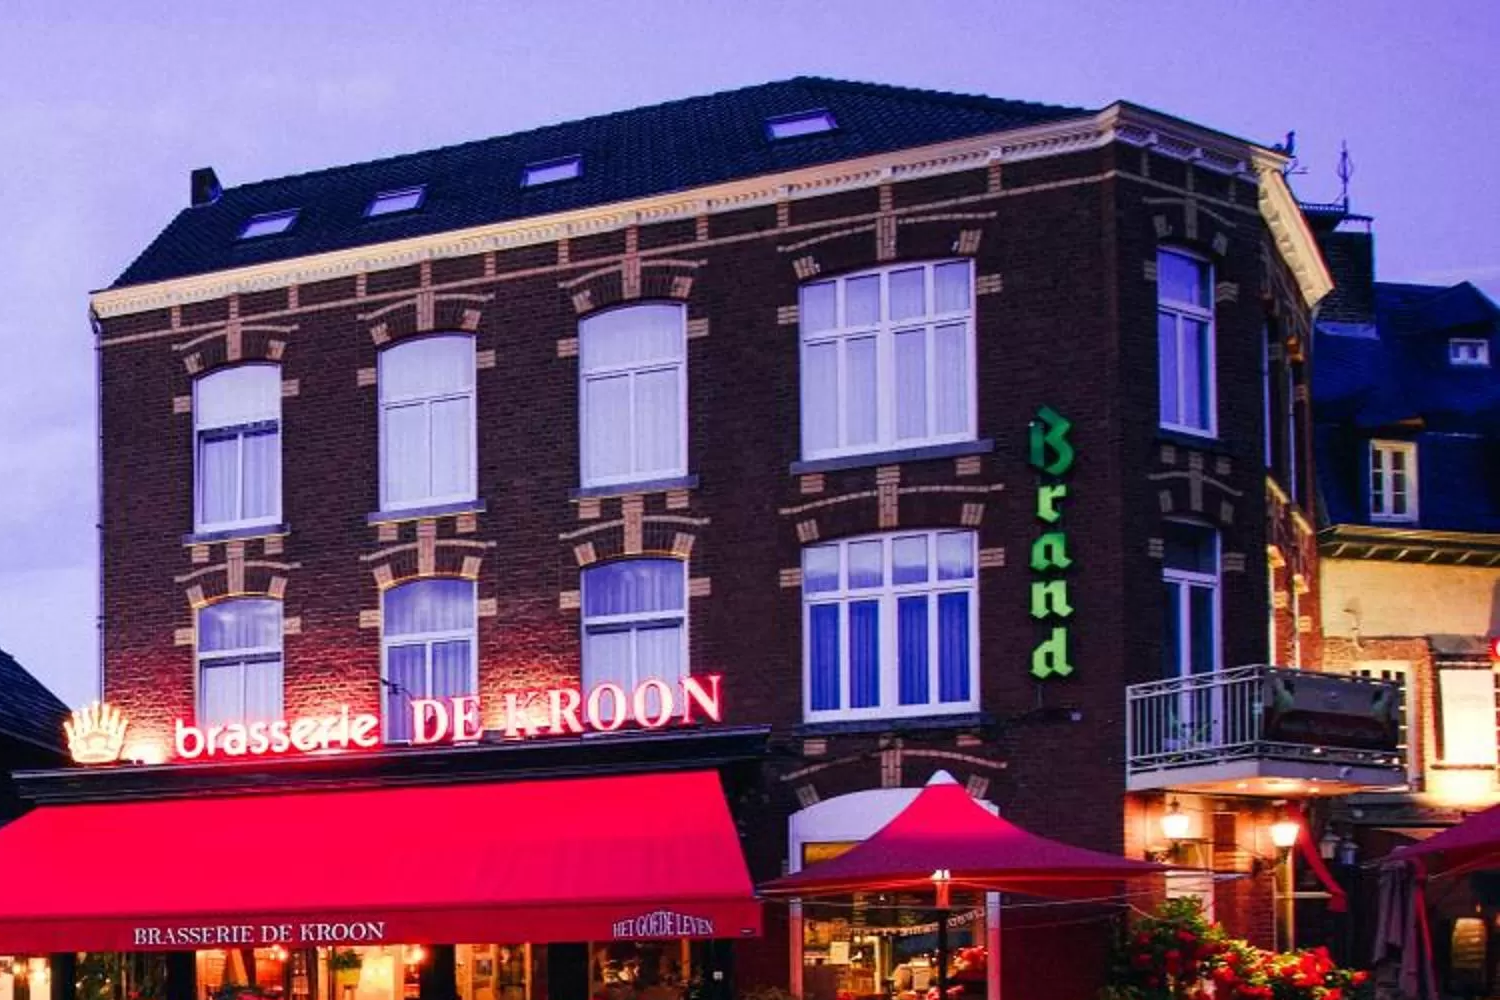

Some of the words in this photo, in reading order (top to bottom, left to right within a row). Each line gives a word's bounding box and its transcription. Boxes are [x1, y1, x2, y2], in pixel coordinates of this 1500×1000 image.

[1028, 404, 1075, 679] Brand
[175, 705, 380, 759] brasserie
[411, 695, 484, 745] DE
[504, 673, 722, 738] KROON
[134, 925, 254, 945] BRASSERIE
[261, 925, 293, 943] DE
[300, 921, 385, 941] KROON
[613, 919, 634, 937] HET
[636, 911, 674, 936] GOEDE
[676, 914, 713, 935] LEVEN
